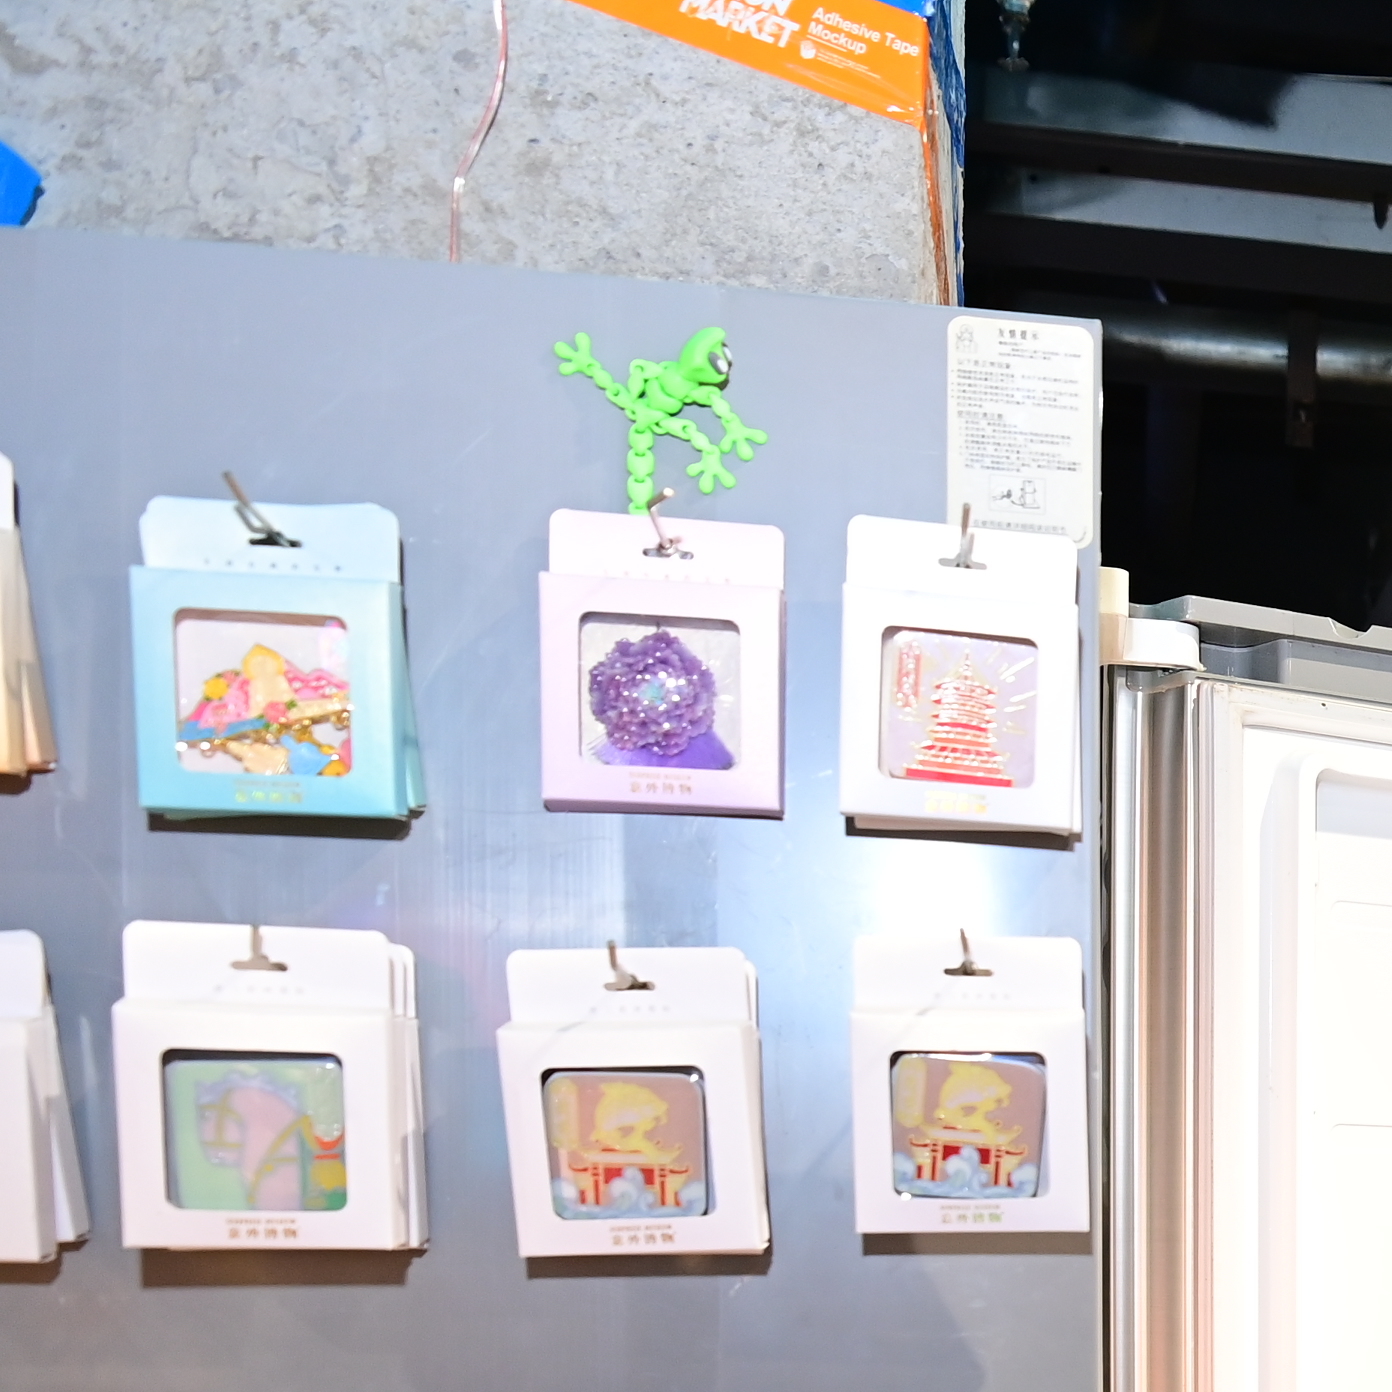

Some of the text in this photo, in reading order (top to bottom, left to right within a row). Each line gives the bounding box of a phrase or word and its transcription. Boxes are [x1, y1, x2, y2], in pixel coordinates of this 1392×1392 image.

[807, 22, 867, 55] Mockup
[811, 6, 881, 43] Adhesive
[884, 31, 920, 57] Tape
